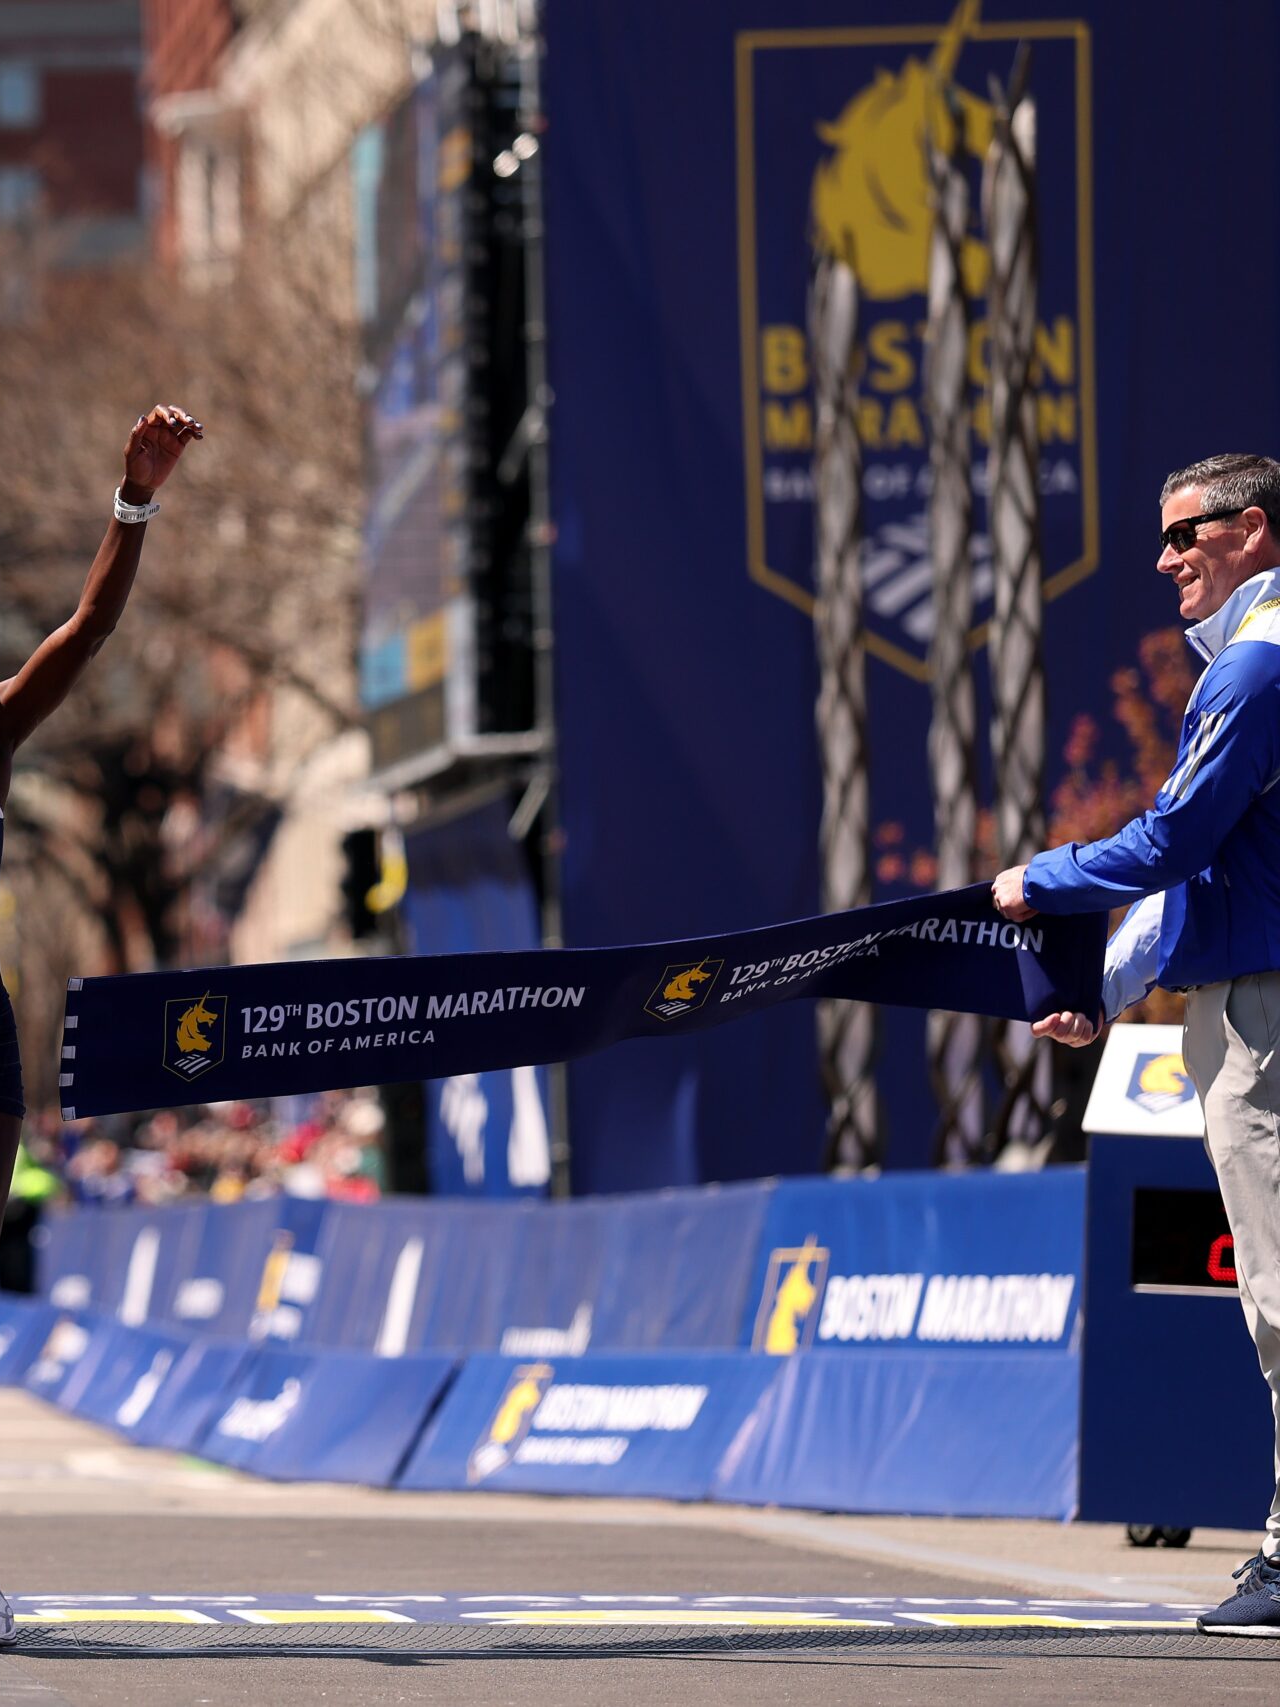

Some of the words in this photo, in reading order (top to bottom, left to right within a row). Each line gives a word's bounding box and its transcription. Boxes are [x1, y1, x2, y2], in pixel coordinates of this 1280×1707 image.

[720, 980, 771, 1003] BANK
[774, 973, 799, 986] OF
[800, 944, 880, 979] AMERICA
[729, 957, 785, 986] 129TH
[781, 932, 882, 973] BOSTON
[241, 1004, 302, 1034] 129TH
[306, 996, 419, 1029] BOSTON
[426, 986, 586, 1019] MARATHON
[242, 1041, 301, 1059] BANK
[307, 1039, 335, 1054] OF
[339, 1030, 435, 1051] AMERICA
